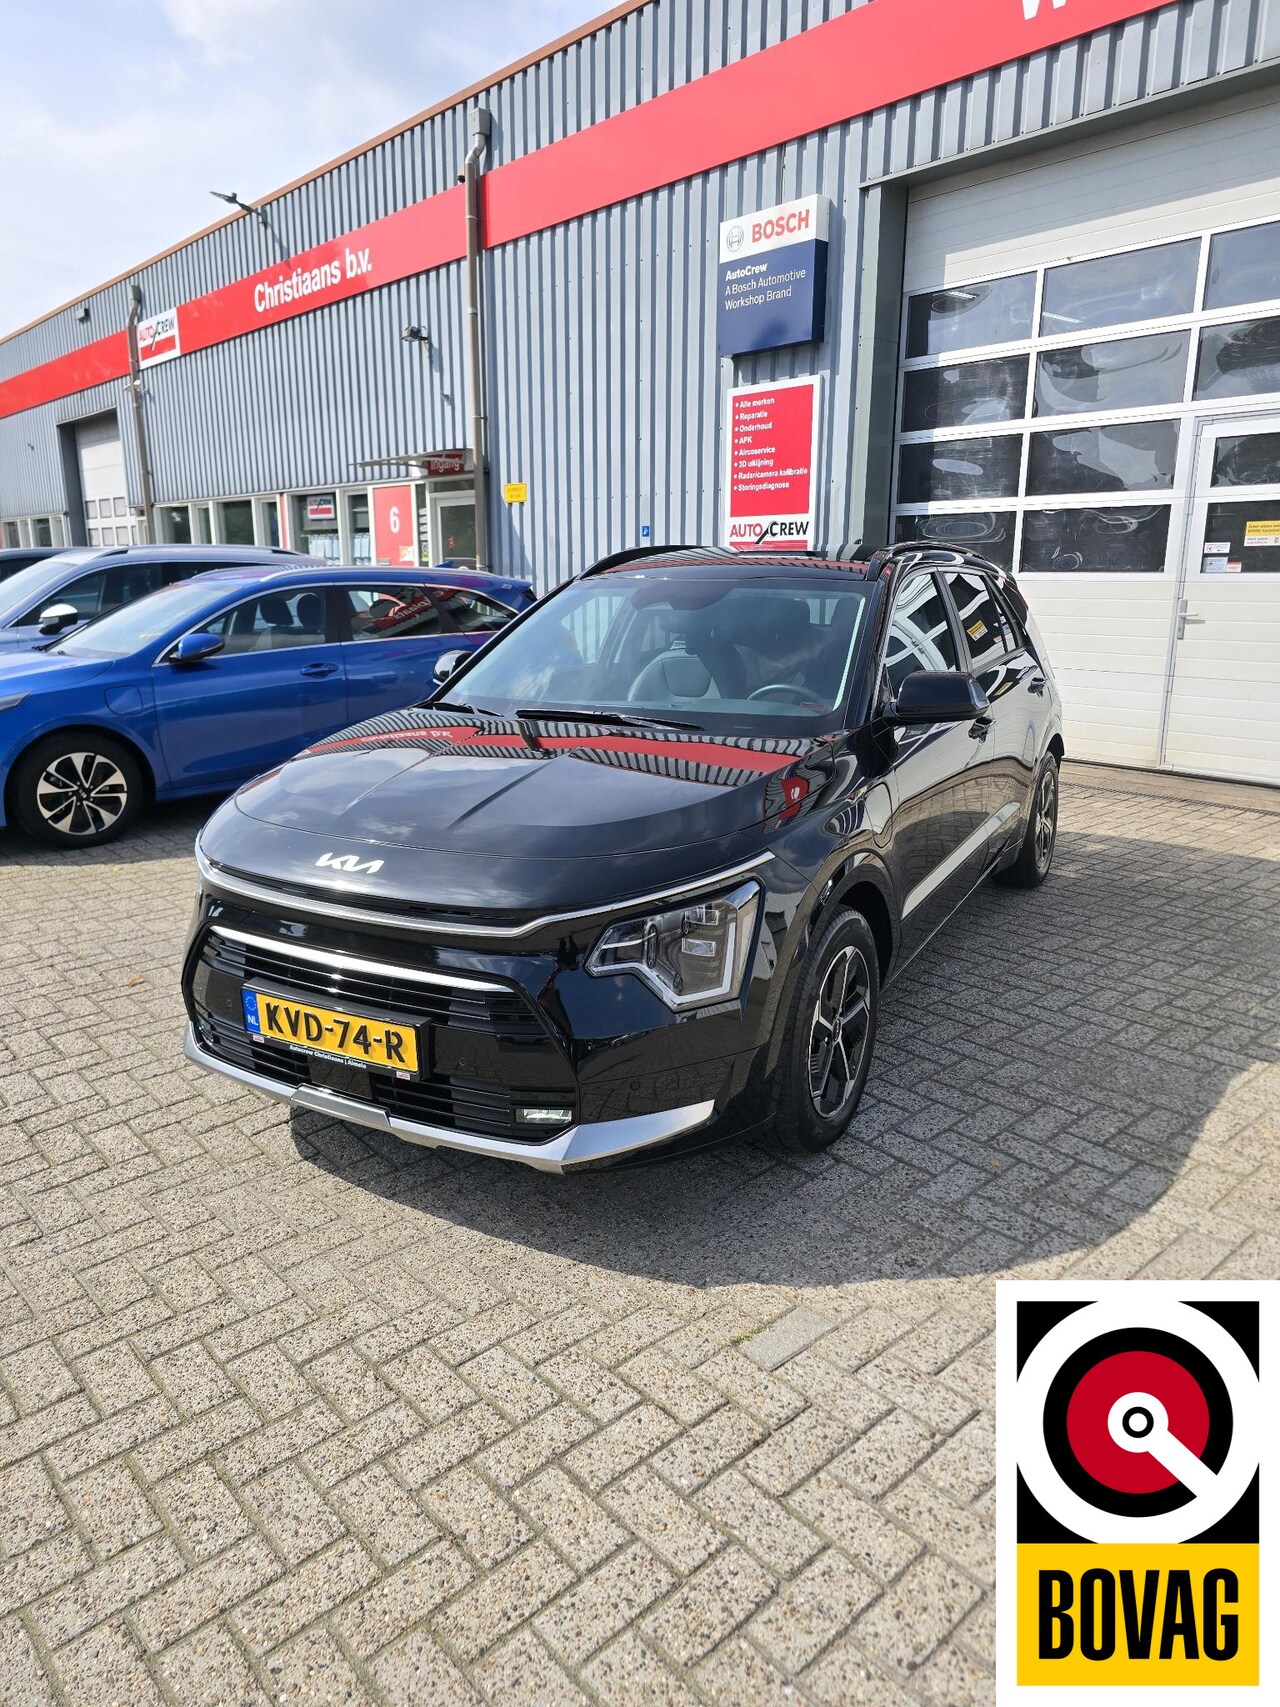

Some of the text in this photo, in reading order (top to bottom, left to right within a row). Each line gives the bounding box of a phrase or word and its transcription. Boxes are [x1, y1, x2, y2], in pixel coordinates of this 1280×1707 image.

[751, 209, 810, 243] BOSCH
[254, 247, 373, 313] Christiaans b.v.
[725, 262, 768, 281] AutoCrew
[724, 269, 807, 296] A Bosch Automotive
[724, 285, 792, 311] Workshop Brand
[739, 397, 775, 408] Alle merken
[739, 410, 769, 421] Reparatie
[739, 421, 773, 433] Onderhoud
[738, 435, 753, 444] APK
[738, 446, 776, 456] Aircoservice
[738, 459, 774, 468] 3D uitlijning
[779, 467, 808, 476] kalibratie
[737, 481, 790, 492] Storingsdiagnose
[389, 506, 401, 534] 6
[729, 520, 810, 537] AUTO CREW
[315, 852, 385, 874] KIA
[247, 1014, 259, 1026] NL
[265, 1002, 406, 1063] KVD-74-R
[289, 1045, 314, 1056] Autocrew
[314, 1051, 344, 1064] Christiaans
[347, 1060, 367, 1069] Almelo
